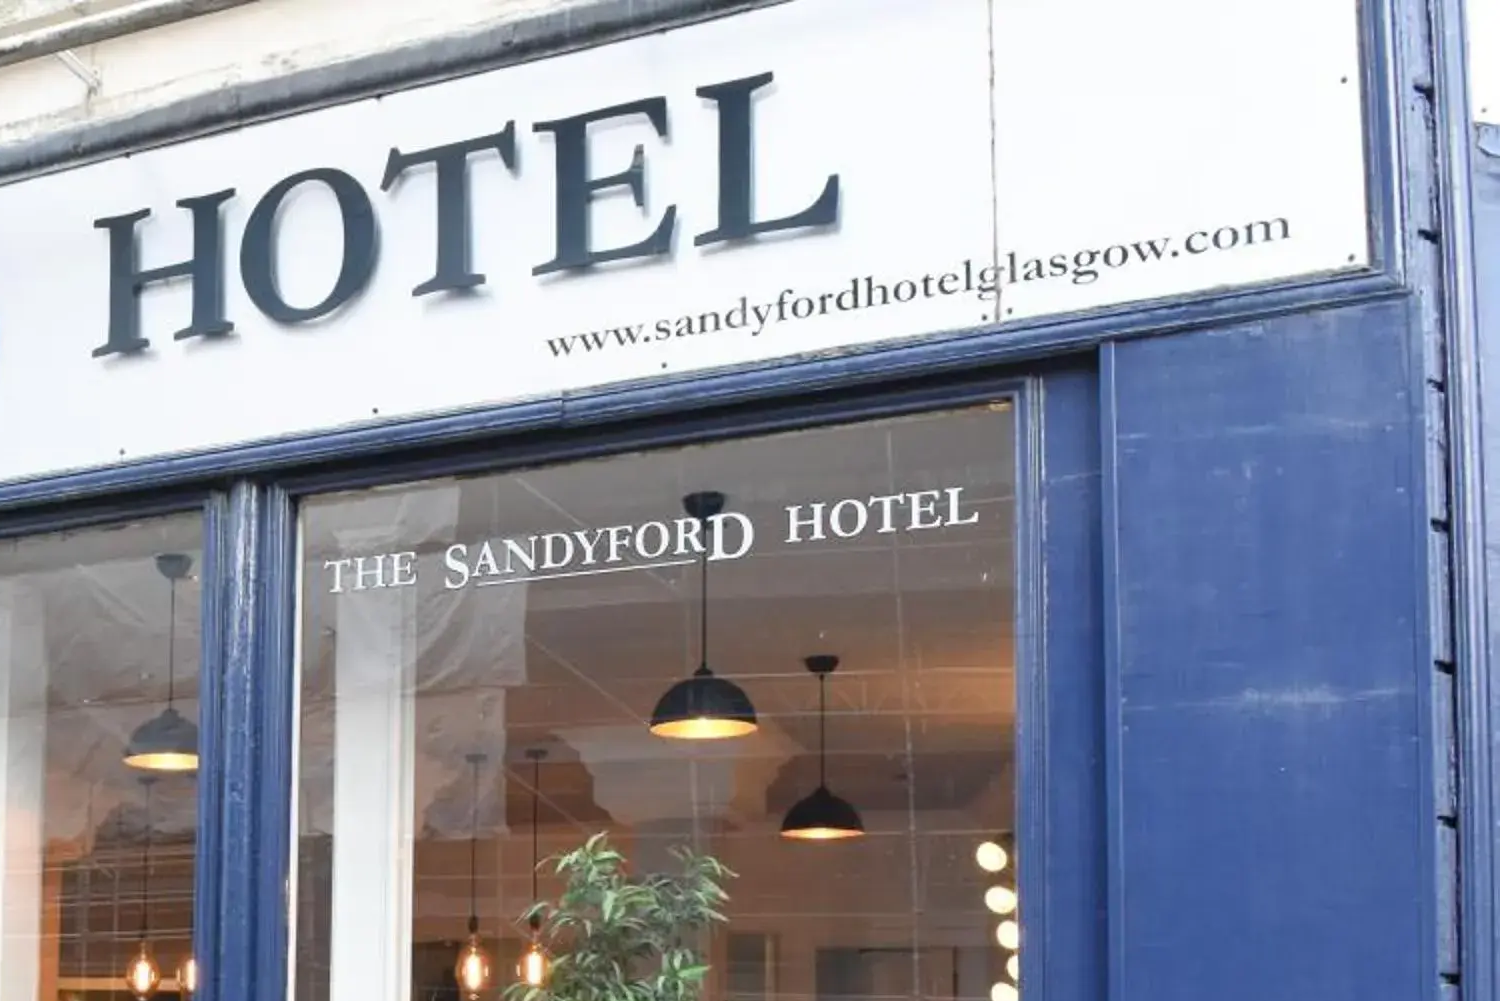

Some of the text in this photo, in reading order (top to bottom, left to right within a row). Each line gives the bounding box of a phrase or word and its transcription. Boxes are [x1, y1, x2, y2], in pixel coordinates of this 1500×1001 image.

[93, 71, 839, 357] HOTEL
[546, 217, 1291, 358] www.sandyfordhotelglasgow.com
[324, 487, 980, 594] THE SANDYFORD HOTEL
